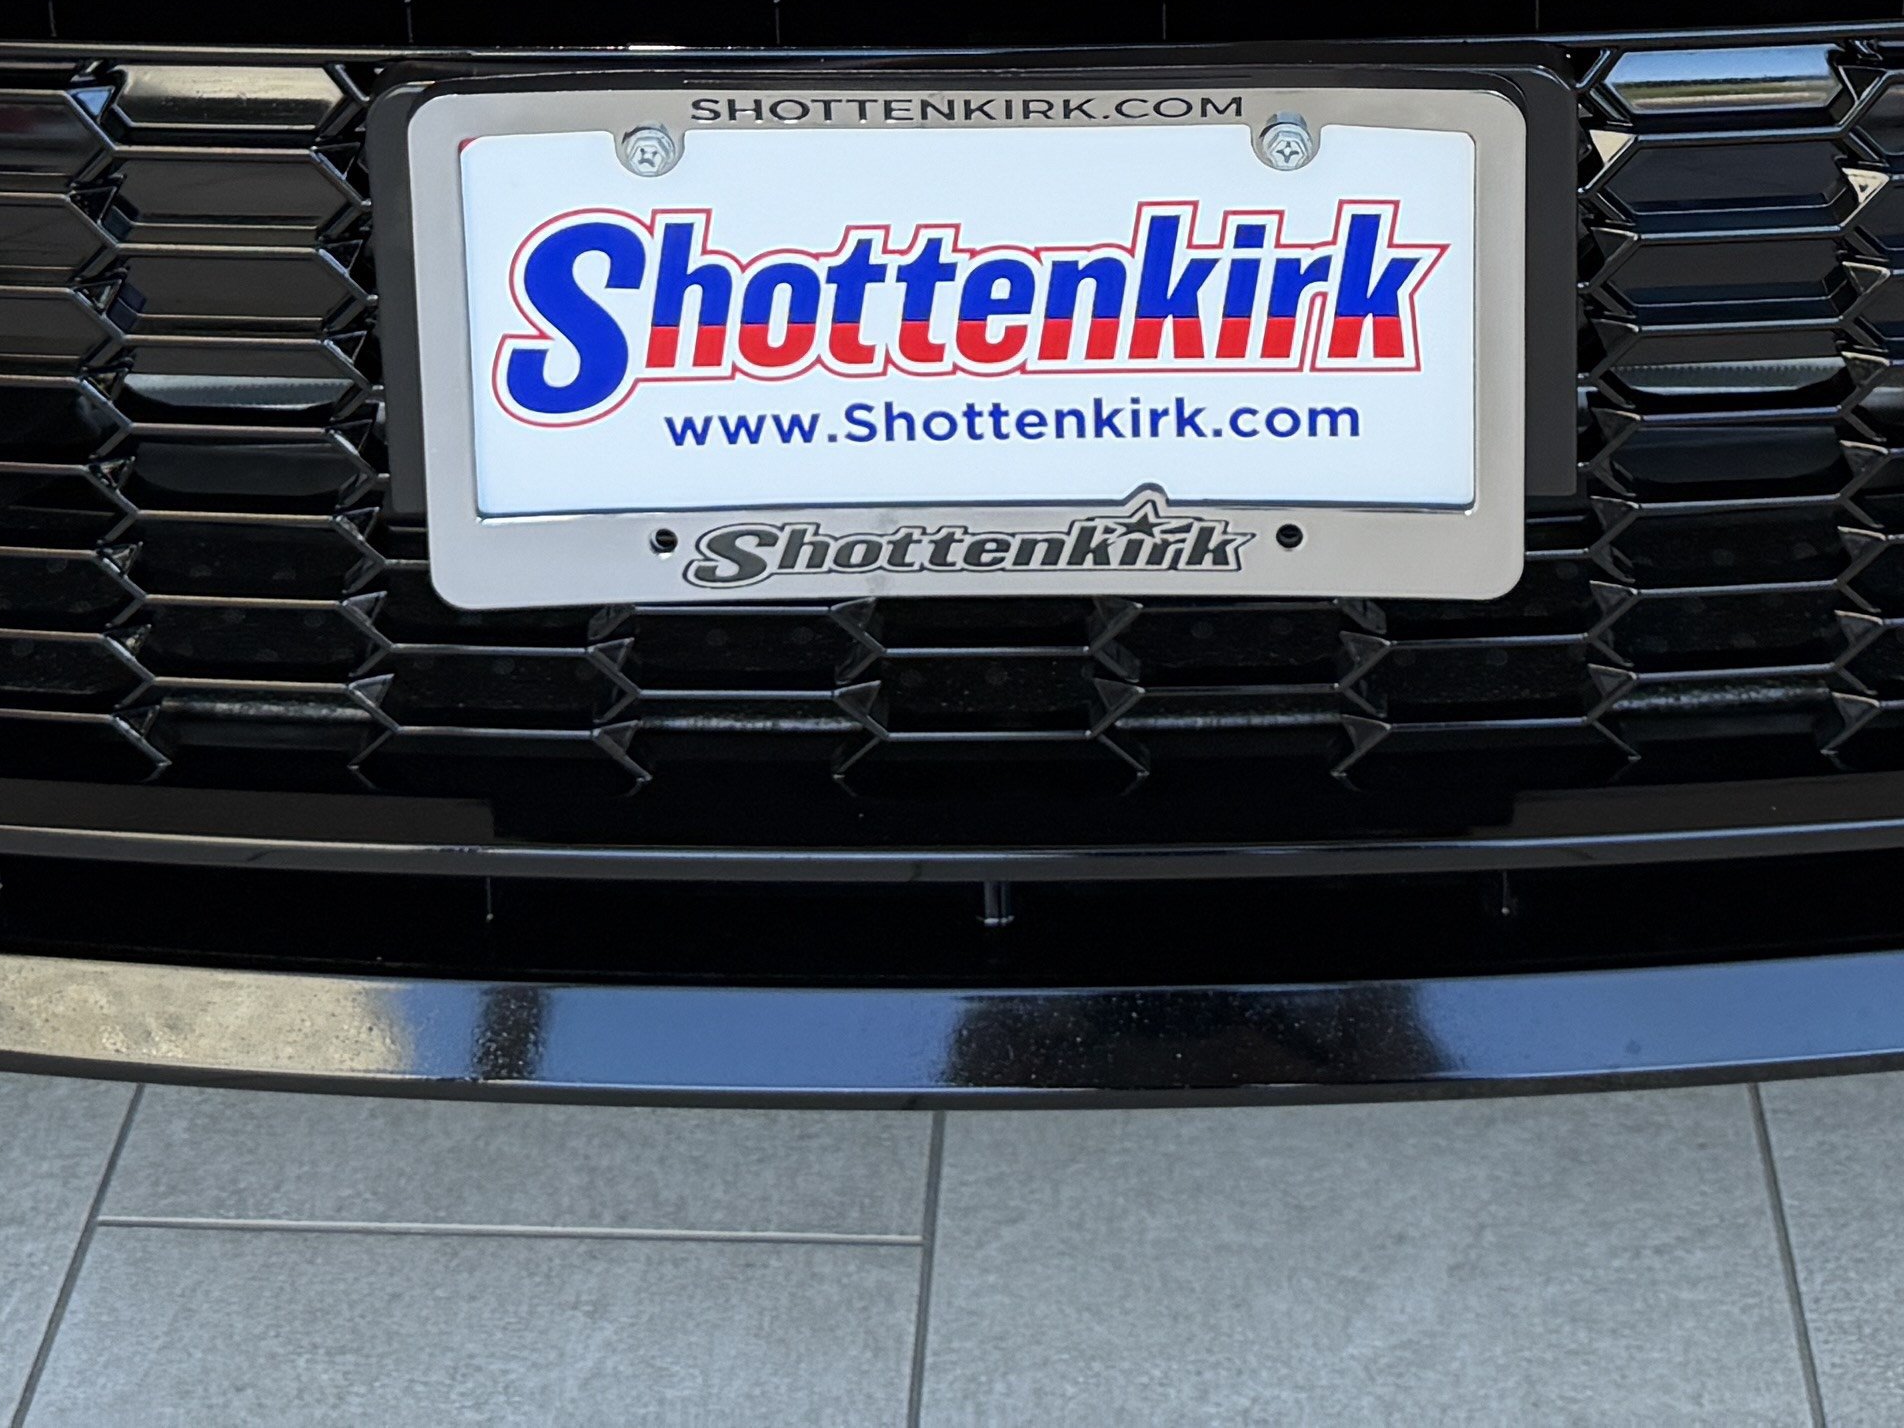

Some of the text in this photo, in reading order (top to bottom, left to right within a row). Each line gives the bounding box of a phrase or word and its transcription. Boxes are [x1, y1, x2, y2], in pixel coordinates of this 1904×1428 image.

[689, 95, 1244, 124] SHOTTENKIRK.COM
[495, 201, 1447, 425] Shottenkirk
[665, 398, 1361, 447] www.Shottenkirk.com
[684, 510, 1256, 590] Shottenkirk
